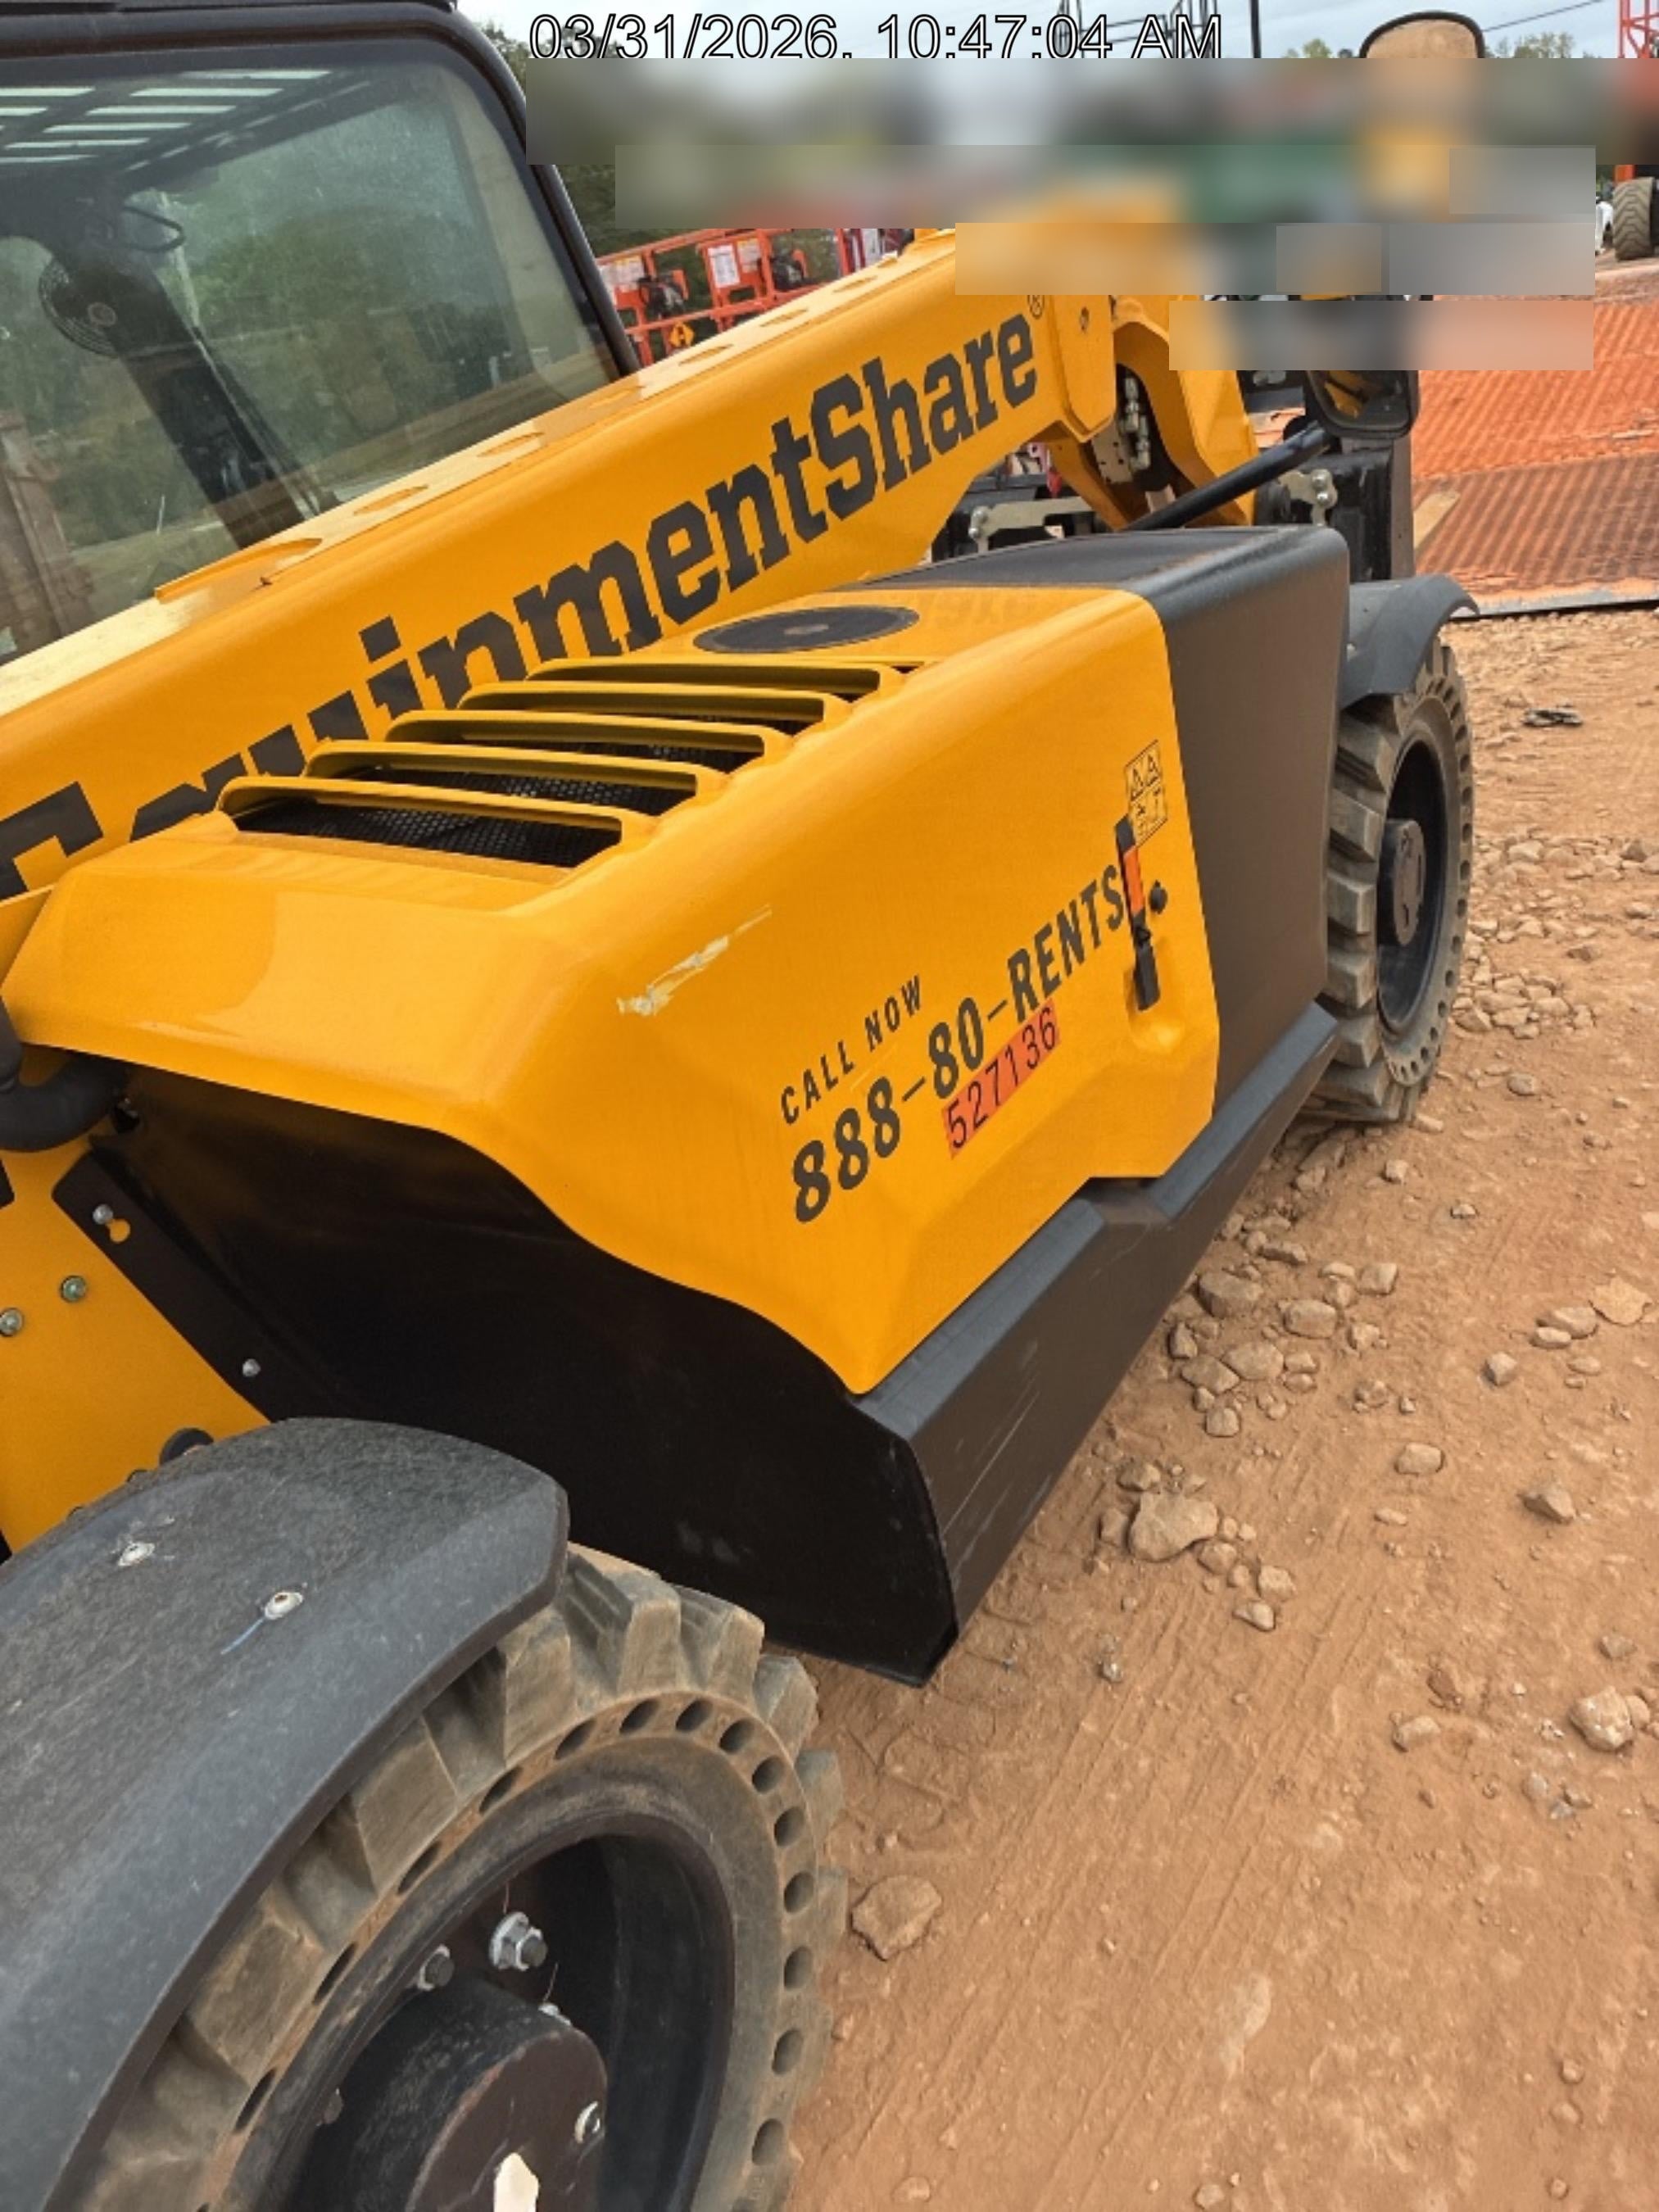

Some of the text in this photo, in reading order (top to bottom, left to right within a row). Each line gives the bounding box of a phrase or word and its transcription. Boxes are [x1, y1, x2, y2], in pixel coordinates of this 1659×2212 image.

[0, 313, 1038, 900] ipmentShare
[781, 974, 923, 1125] CALL NOW
[791, 863, 1126, 1224] 888-80-RENTS
[947, 1007, 1058, 1149] 527136
